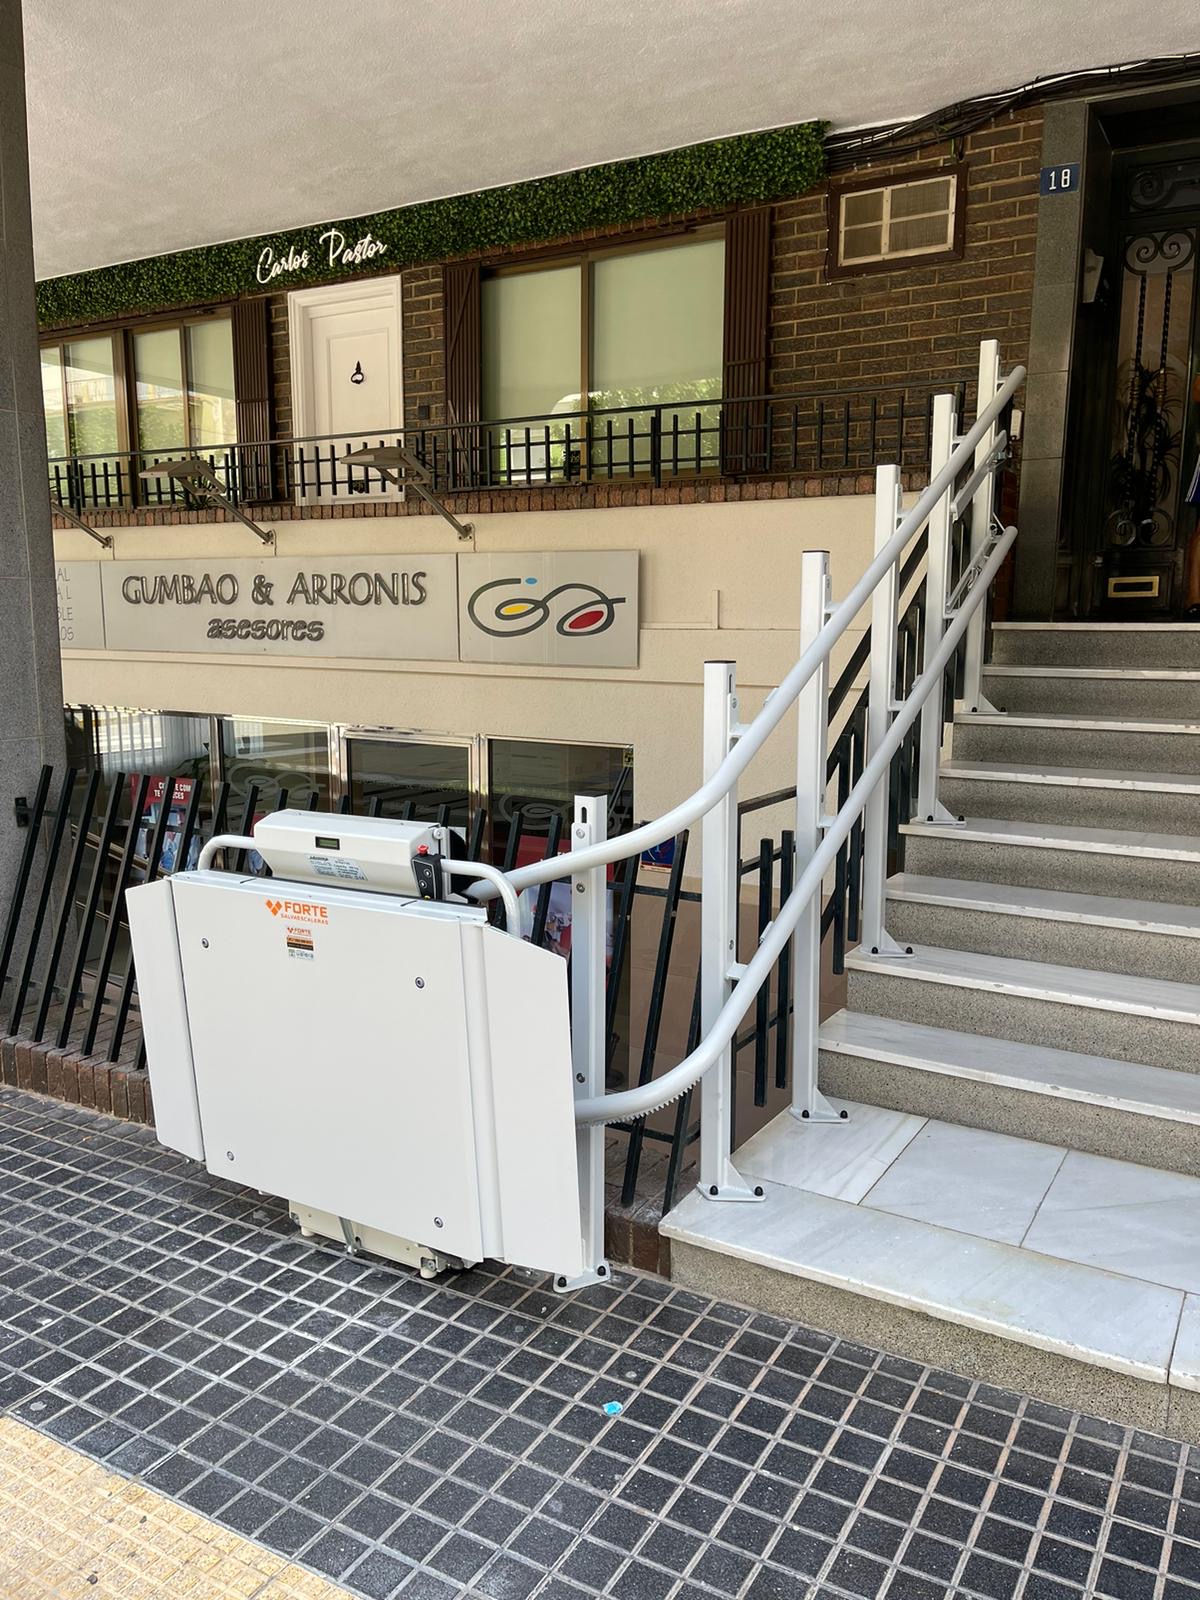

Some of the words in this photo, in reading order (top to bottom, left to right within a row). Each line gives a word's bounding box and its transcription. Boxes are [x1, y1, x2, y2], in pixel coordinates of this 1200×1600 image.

[1049, 168, 1071, 190] 18
[256, 246, 310, 284] Carlos
[319, 228, 387, 267] Pastor
[121, 573, 240, 606] GUMBAO
[251, 574, 275, 606] &
[288, 571, 428, 606] ARRONIS
[207, 617, 325, 642] asesores
[280, 913, 329, 925] SALVAESCALERAS
[284, 901, 328, 918] FORTE
